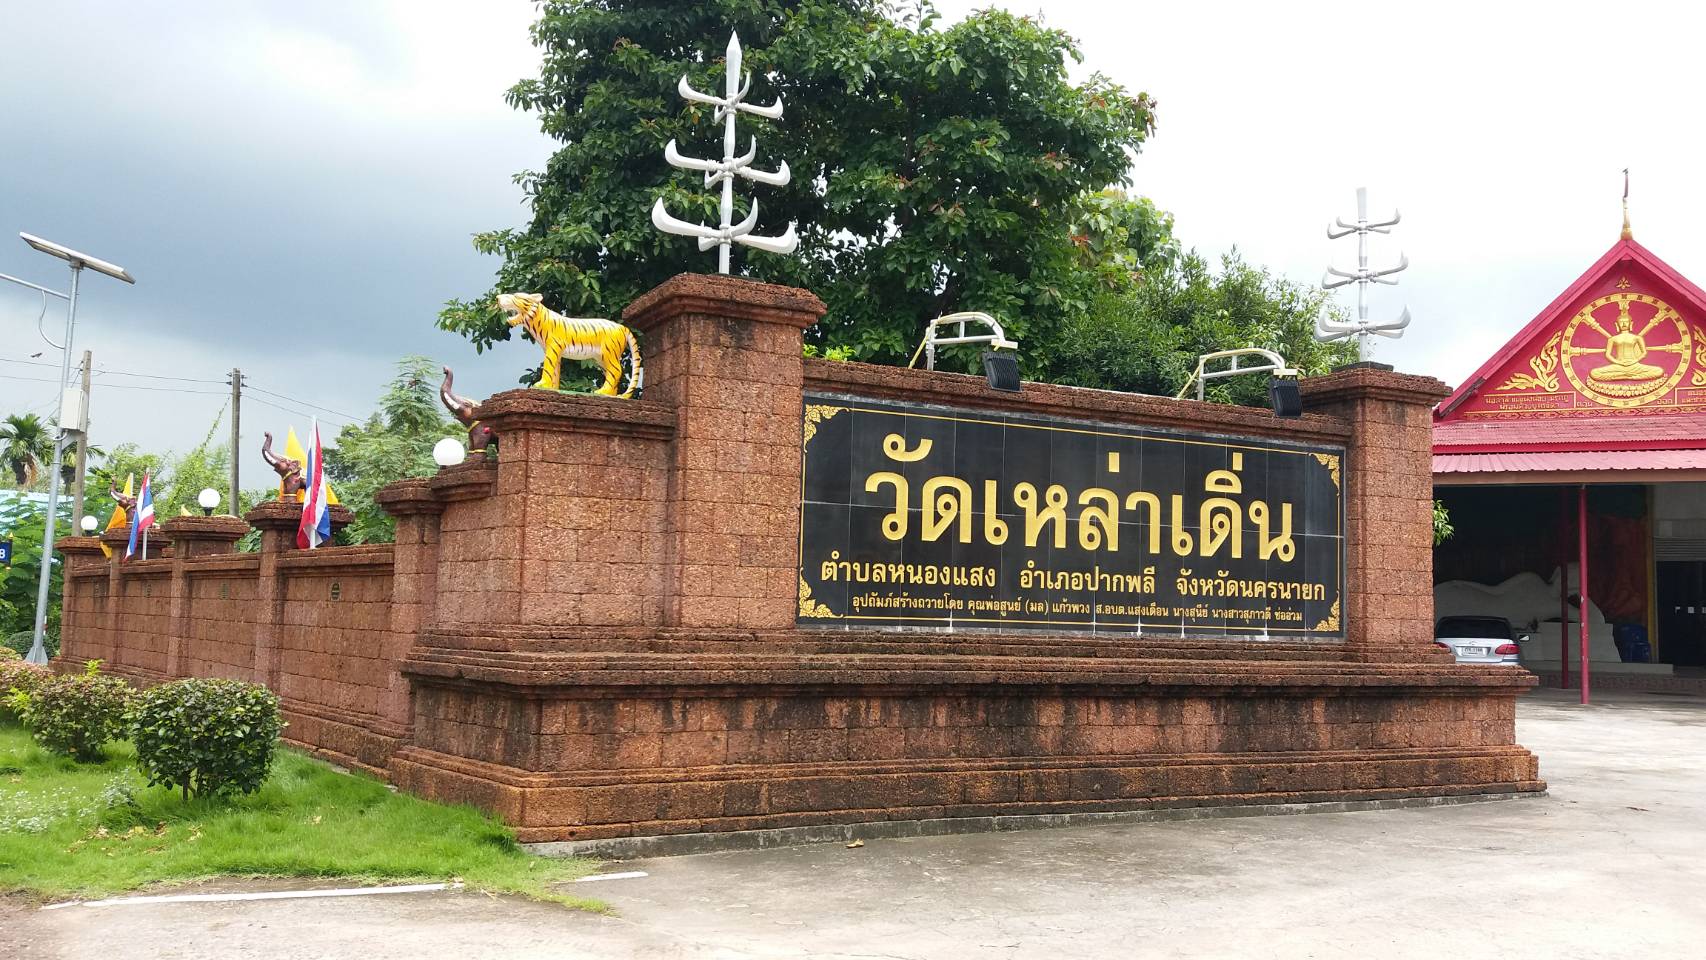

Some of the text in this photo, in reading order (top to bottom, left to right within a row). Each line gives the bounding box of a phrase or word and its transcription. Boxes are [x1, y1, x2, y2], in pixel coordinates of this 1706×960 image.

[865, 433, 1296, 563] วัดเหล่าเดิ่น
[821, 550, 1325, 600] ตำบลหนองแสง อำเภอปากพลี จังหวัดนครนายก
[852, 592, 964, 612] อุปถัมภ์สร้างถวายโดย
